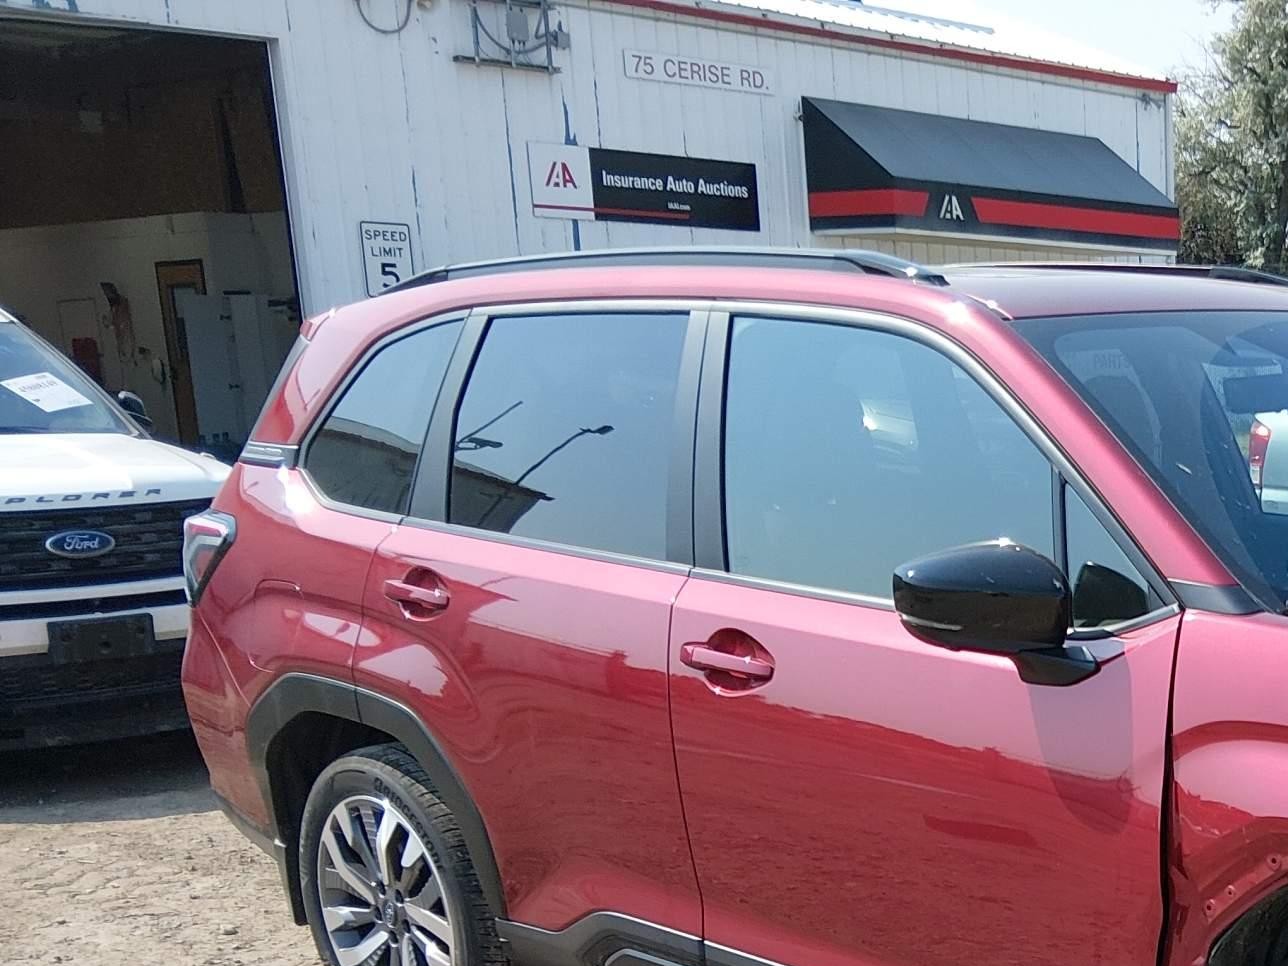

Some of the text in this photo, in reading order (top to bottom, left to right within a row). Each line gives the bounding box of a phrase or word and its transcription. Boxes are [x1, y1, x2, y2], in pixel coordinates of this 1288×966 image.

[631, 54, 769, 90] 75 CERISE RD.
[602, 169, 749, 199] Insurance Auto Auctions
[364, 229, 408, 242] SPEED
[370, 245, 404, 258] LIMIT
[380, 262, 401, 289] 5
[63, 535, 100, 550] Ford
